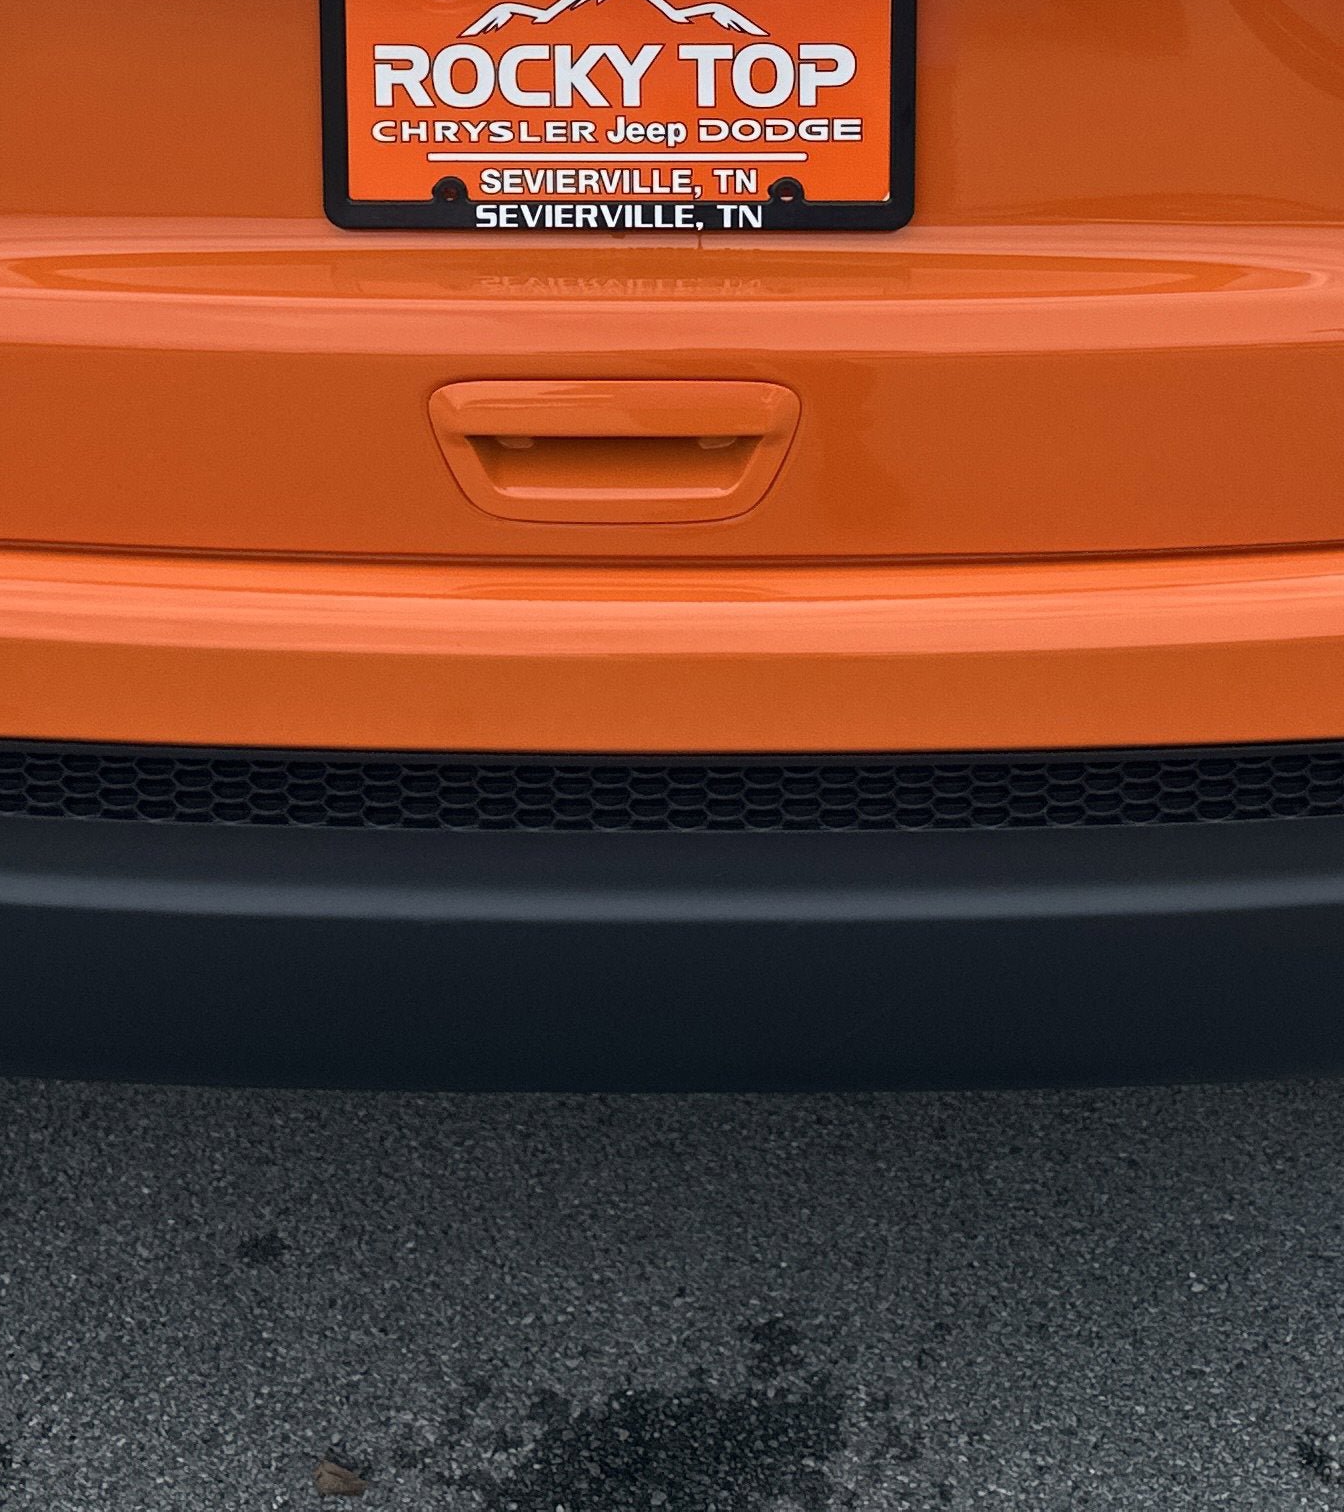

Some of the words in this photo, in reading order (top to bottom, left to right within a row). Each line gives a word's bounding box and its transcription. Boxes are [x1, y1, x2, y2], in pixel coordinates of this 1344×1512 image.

[373, 43, 663, 108] ROCKY
[677, 43, 857, 108] TOP
[371, 119, 596, 143] CHRYSLER
[607, 117, 687, 147] Jeep
[698, 118, 862, 142] DODGE
[480, 169, 703, 199] SEVIERVILLE,
[713, 169, 758, 193] TN
[475, 204, 704, 230] SEVIERVILLE,
[717, 204, 763, 228] TN
